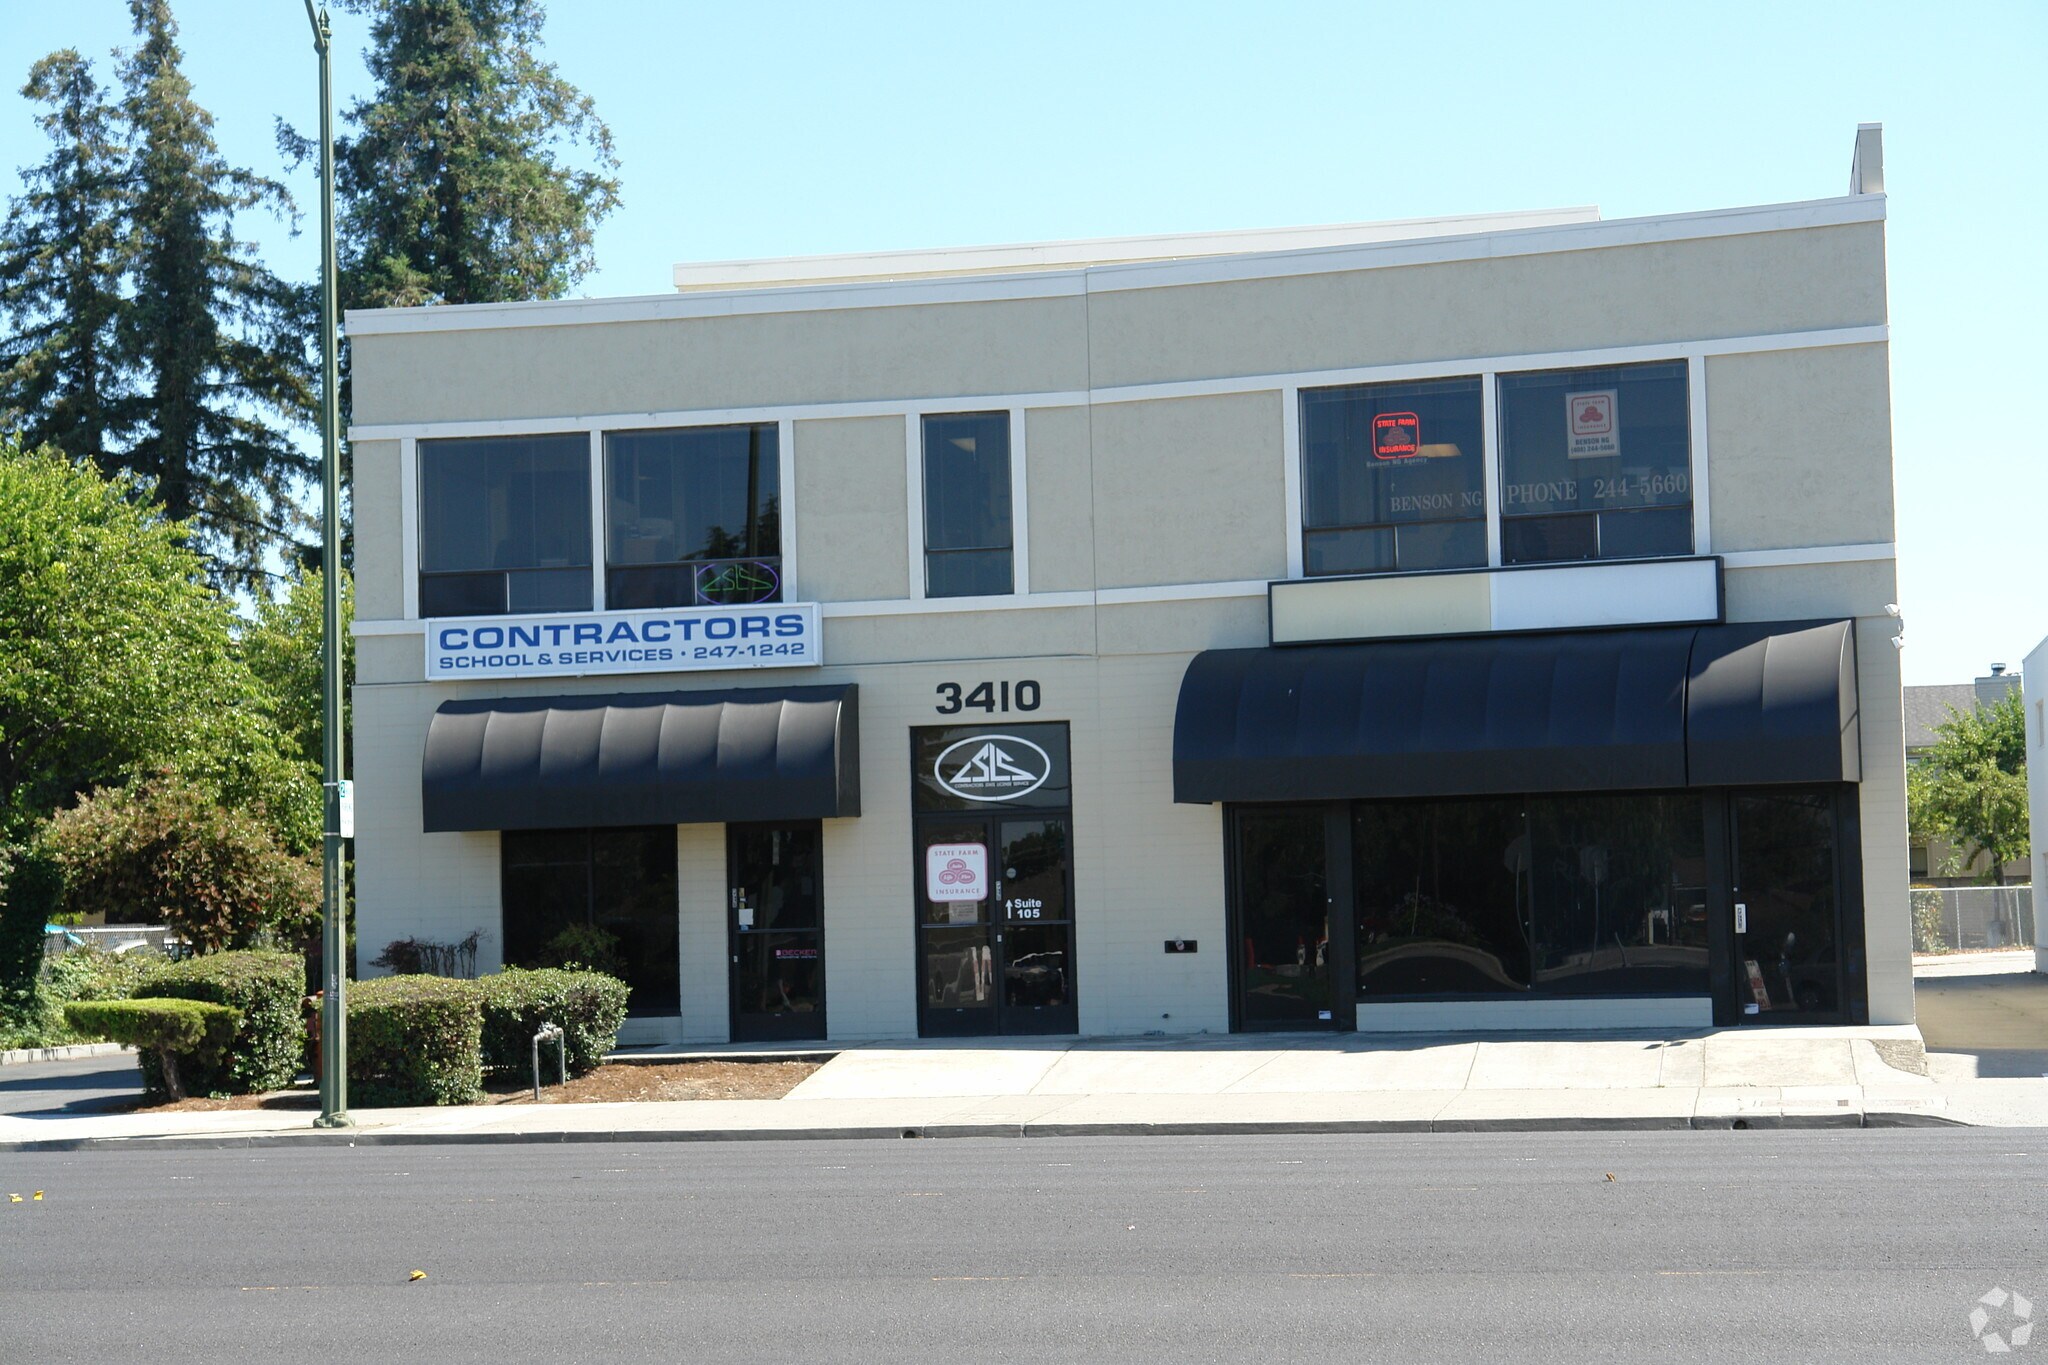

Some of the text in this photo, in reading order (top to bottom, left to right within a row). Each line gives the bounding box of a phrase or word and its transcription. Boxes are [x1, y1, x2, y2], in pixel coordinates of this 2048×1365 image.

[1377, 418, 1416, 428] STATE FARM
[1378, 444, 1416, 453] INSURANCE
[1506, 472, 1688, 504] PHONE 244-5660
[1390, 490, 1482, 513] BENSON NG
[439, 614, 804, 651] CONTRACTORS
[439, 642, 805, 669] SCHOOL & SERVICES 247-1242
[935, 679, 1041, 714] 3410
[935, 887, 980, 895] INSURANCE
[1014, 898, 1042, 909] Suite
[1016, 909, 1041, 919] 105
